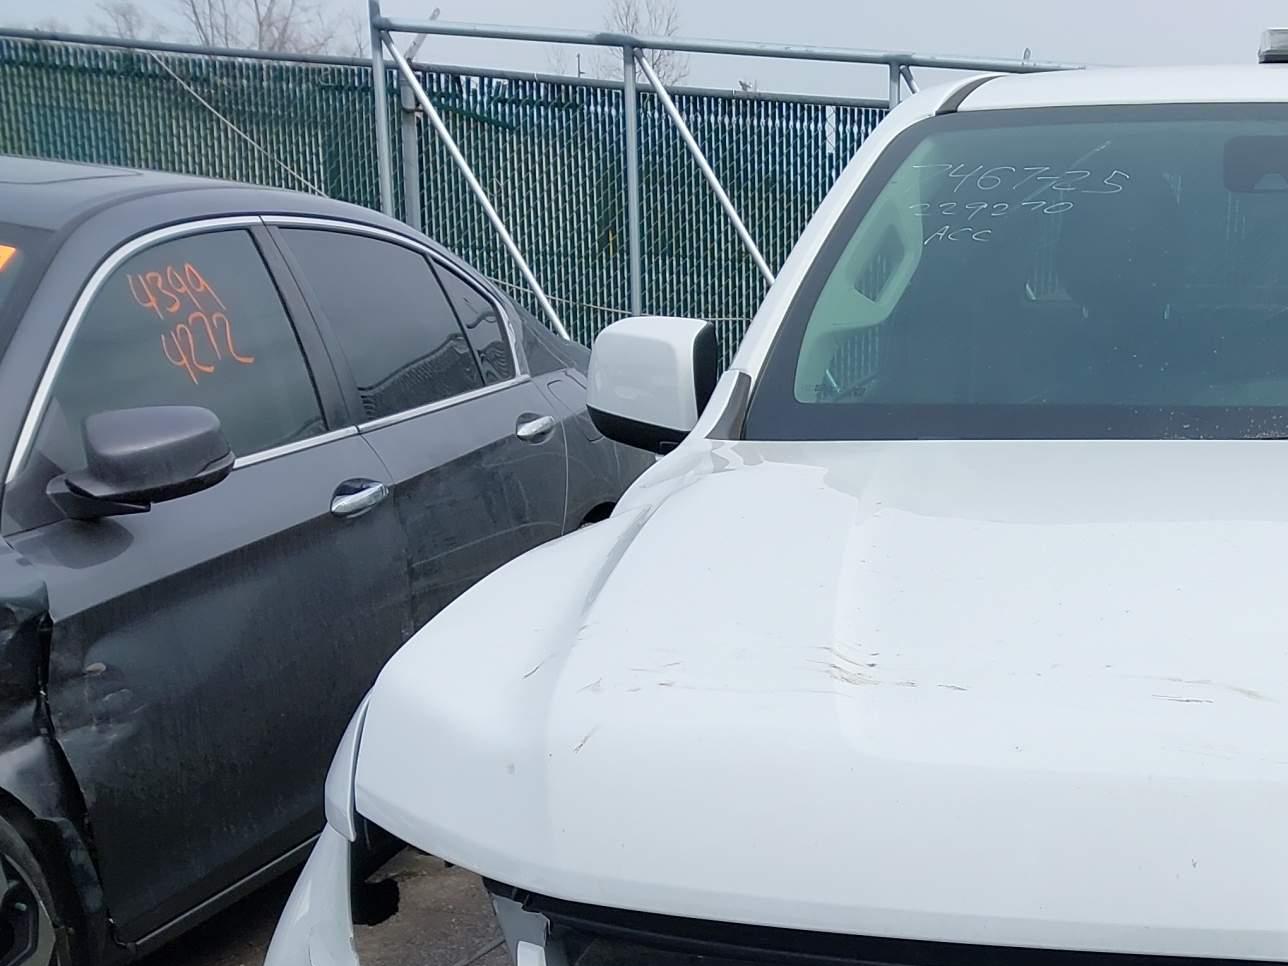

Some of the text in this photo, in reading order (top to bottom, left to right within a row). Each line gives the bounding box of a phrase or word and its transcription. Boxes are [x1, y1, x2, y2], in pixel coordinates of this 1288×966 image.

[923, 224, 993, 245] ACC
[127, 261, 227, 321] 4399
[160, 311, 256, 386] 4272
